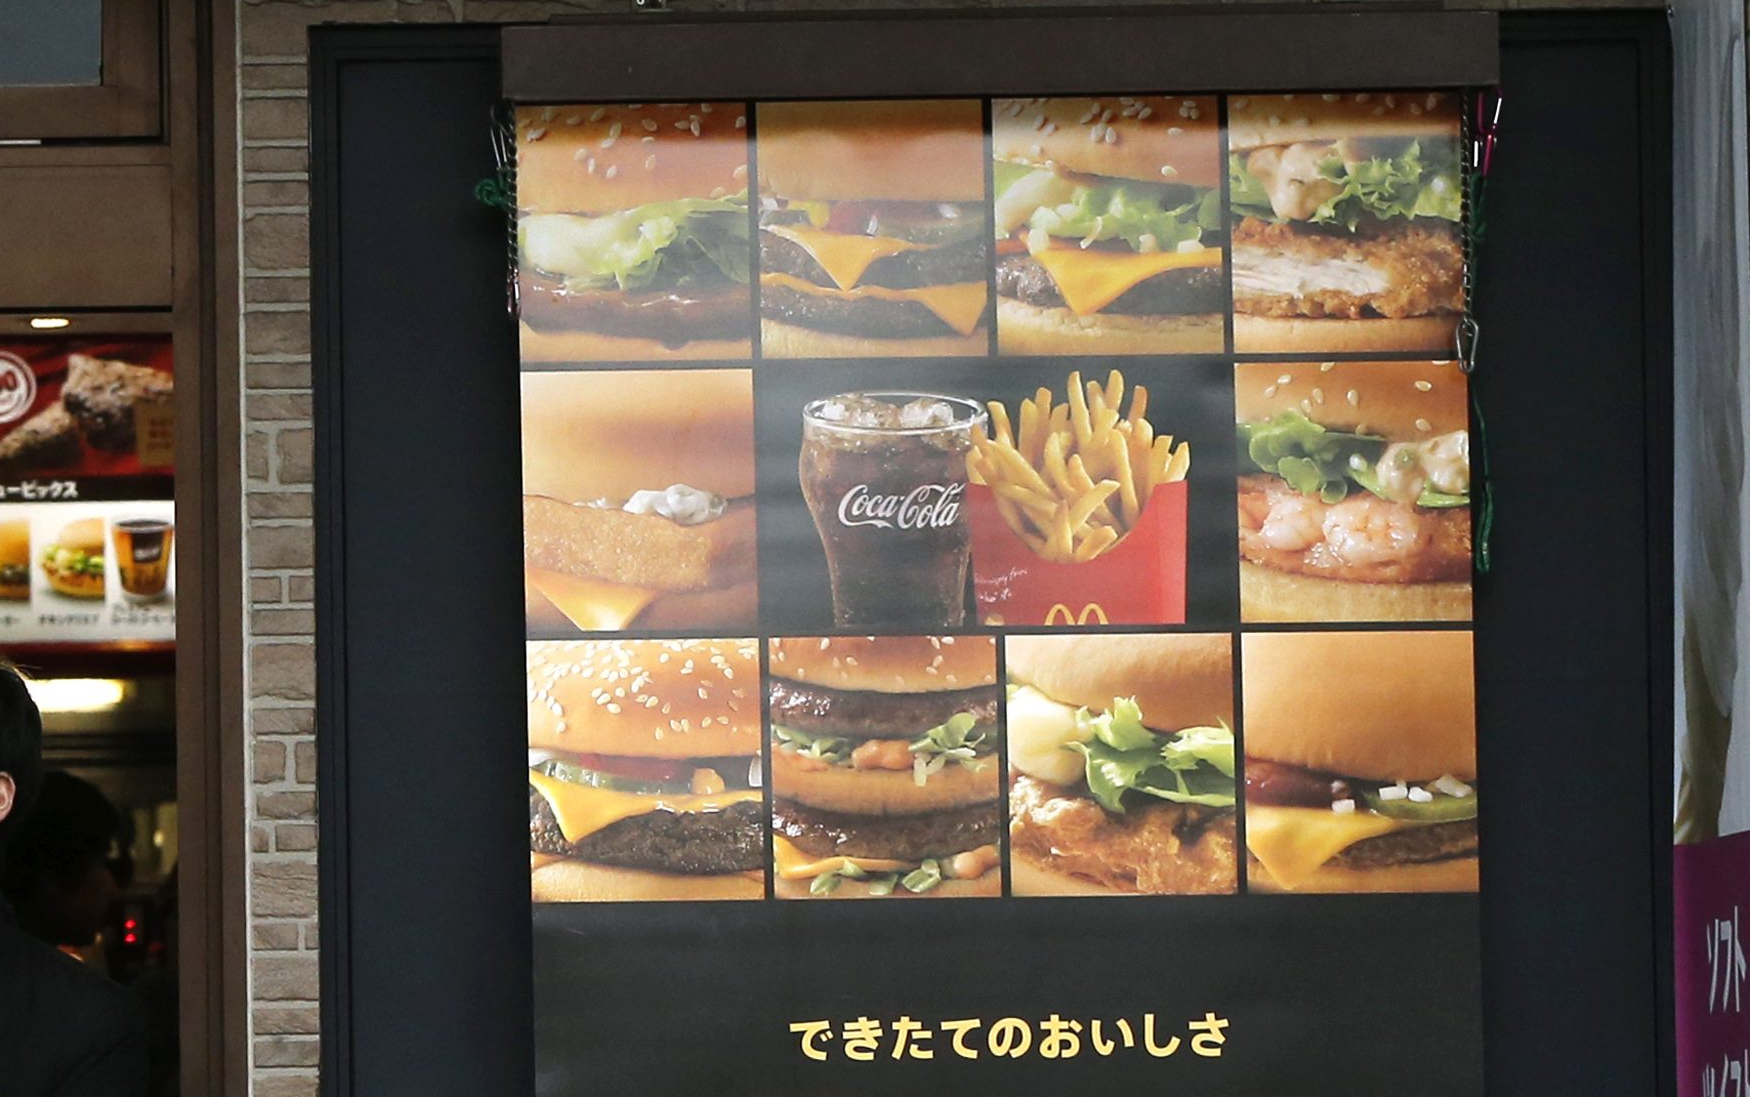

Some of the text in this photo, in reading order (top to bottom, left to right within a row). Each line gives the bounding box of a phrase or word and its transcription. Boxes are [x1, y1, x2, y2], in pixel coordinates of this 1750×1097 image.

[837, 483, 965, 529] Coca-Cola
[789, 1012, 1230, 1061] できたてのおいしさ
